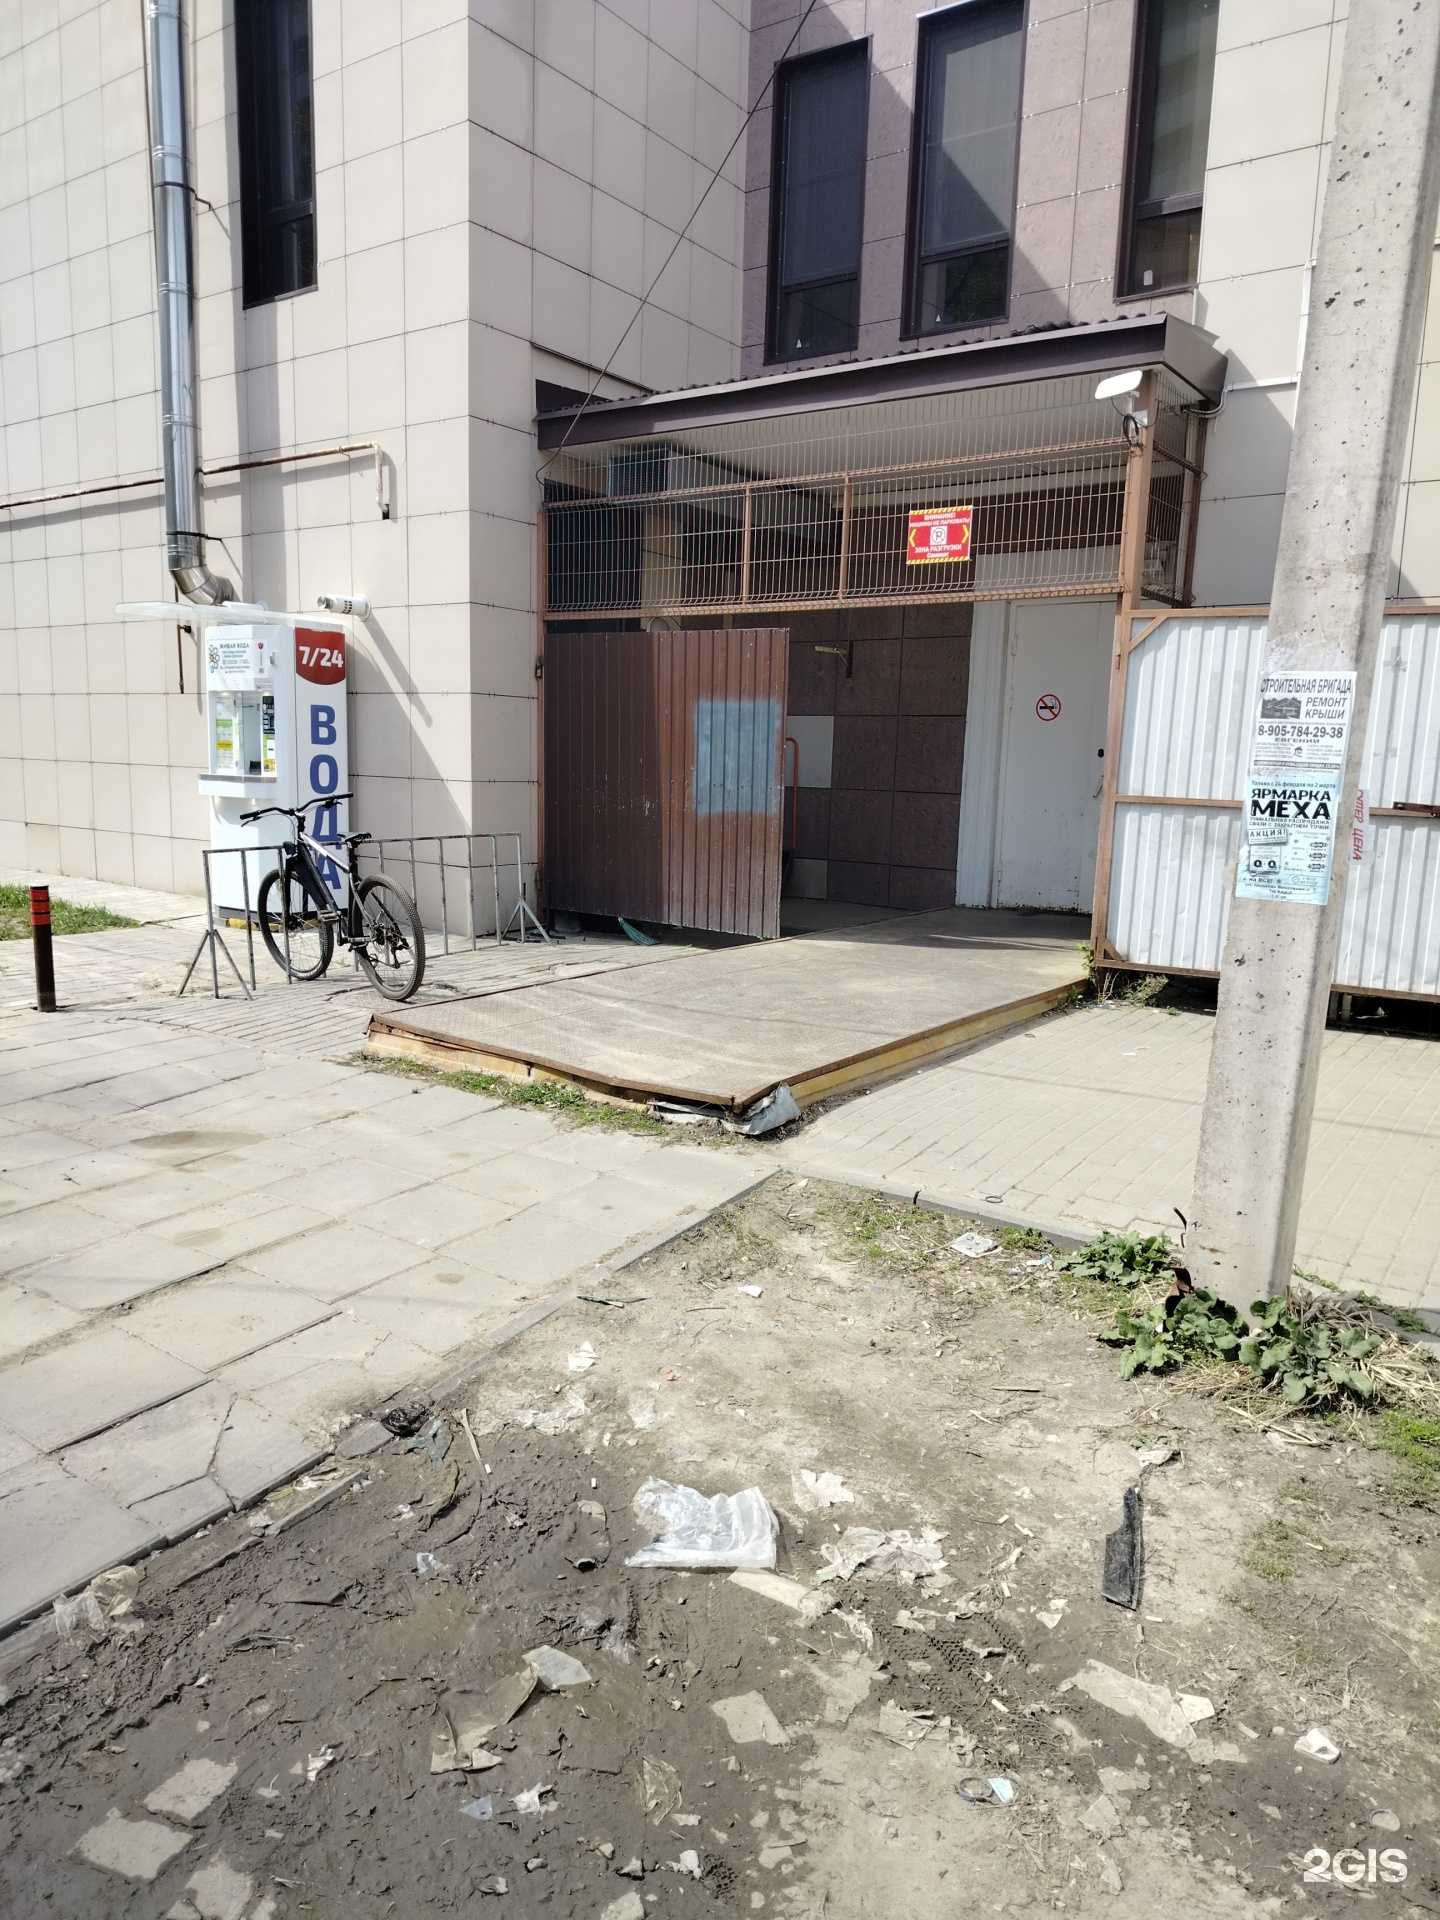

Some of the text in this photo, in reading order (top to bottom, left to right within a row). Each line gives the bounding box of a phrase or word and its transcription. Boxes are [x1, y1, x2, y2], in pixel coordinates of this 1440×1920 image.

[930, 544, 962, 552] РАЗГРУЗКИ
[299, 646, 344, 668] 7/24
[1261, 678, 1352, 696] СТРОИТЕЛЬНАЯ БРИГАДА
[1306, 697, 1348, 708] РЕМОНТ
[1305, 709, 1346, 719] КРЫШИ
[1258, 725, 1343, 738] 8-905-784-29-38
[1251, 788, 1331, 801] ЯРМАРКА
[1251, 799, 1331, 820] МЕХА
[1250, 828, 1287, 838] АКЦИЯ!
[1352, 828, 1364, 861] ЦЕНА
